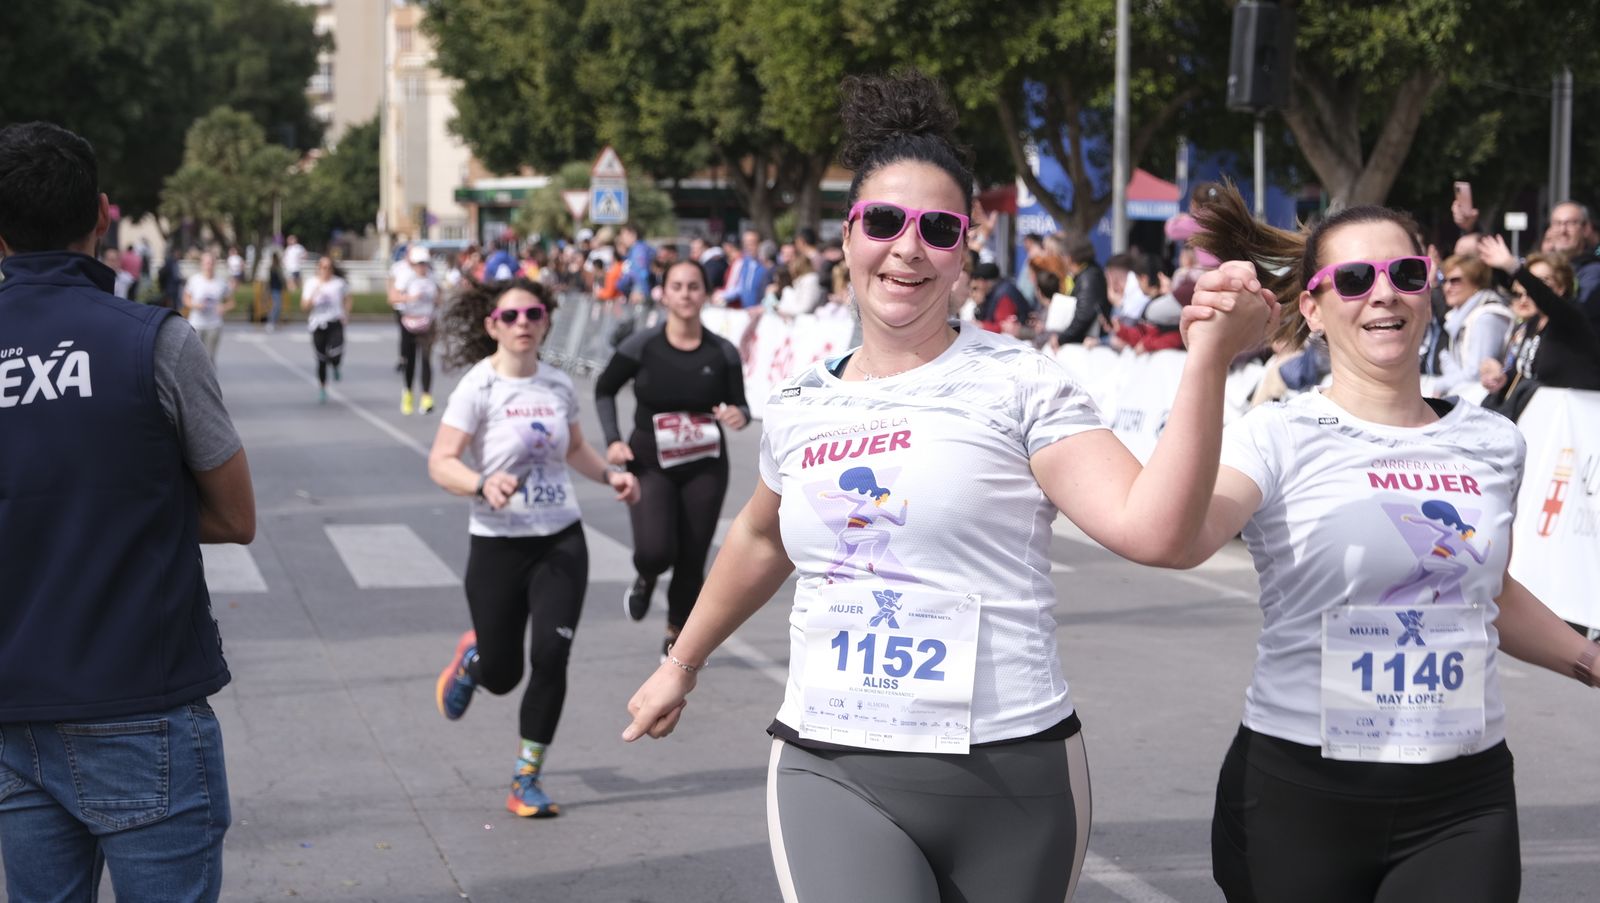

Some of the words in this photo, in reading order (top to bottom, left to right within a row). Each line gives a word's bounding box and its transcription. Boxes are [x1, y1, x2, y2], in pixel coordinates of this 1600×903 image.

[0, 347, 23, 358] UPO
[808, 422, 866, 441] CARRERA
[870, 419, 888, 431] DE
[892, 417, 909, 427] LA
[801, 430, 912, 469] MUJER
[1370, 459, 1430, 471] CARRERA
[1367, 472, 1482, 496] MUJER
[520, 484, 566, 503] 1295
[828, 604, 864, 615] MUJER
[1349, 626, 1390, 637] MUJER
[831, 630, 947, 682] 1152
[1351, 651, 1465, 692] 1146
[862, 676, 899, 690] ALISS
[1376, 693, 1403, 705] MAY
[1408, 693, 1445, 704] LOPEZ
